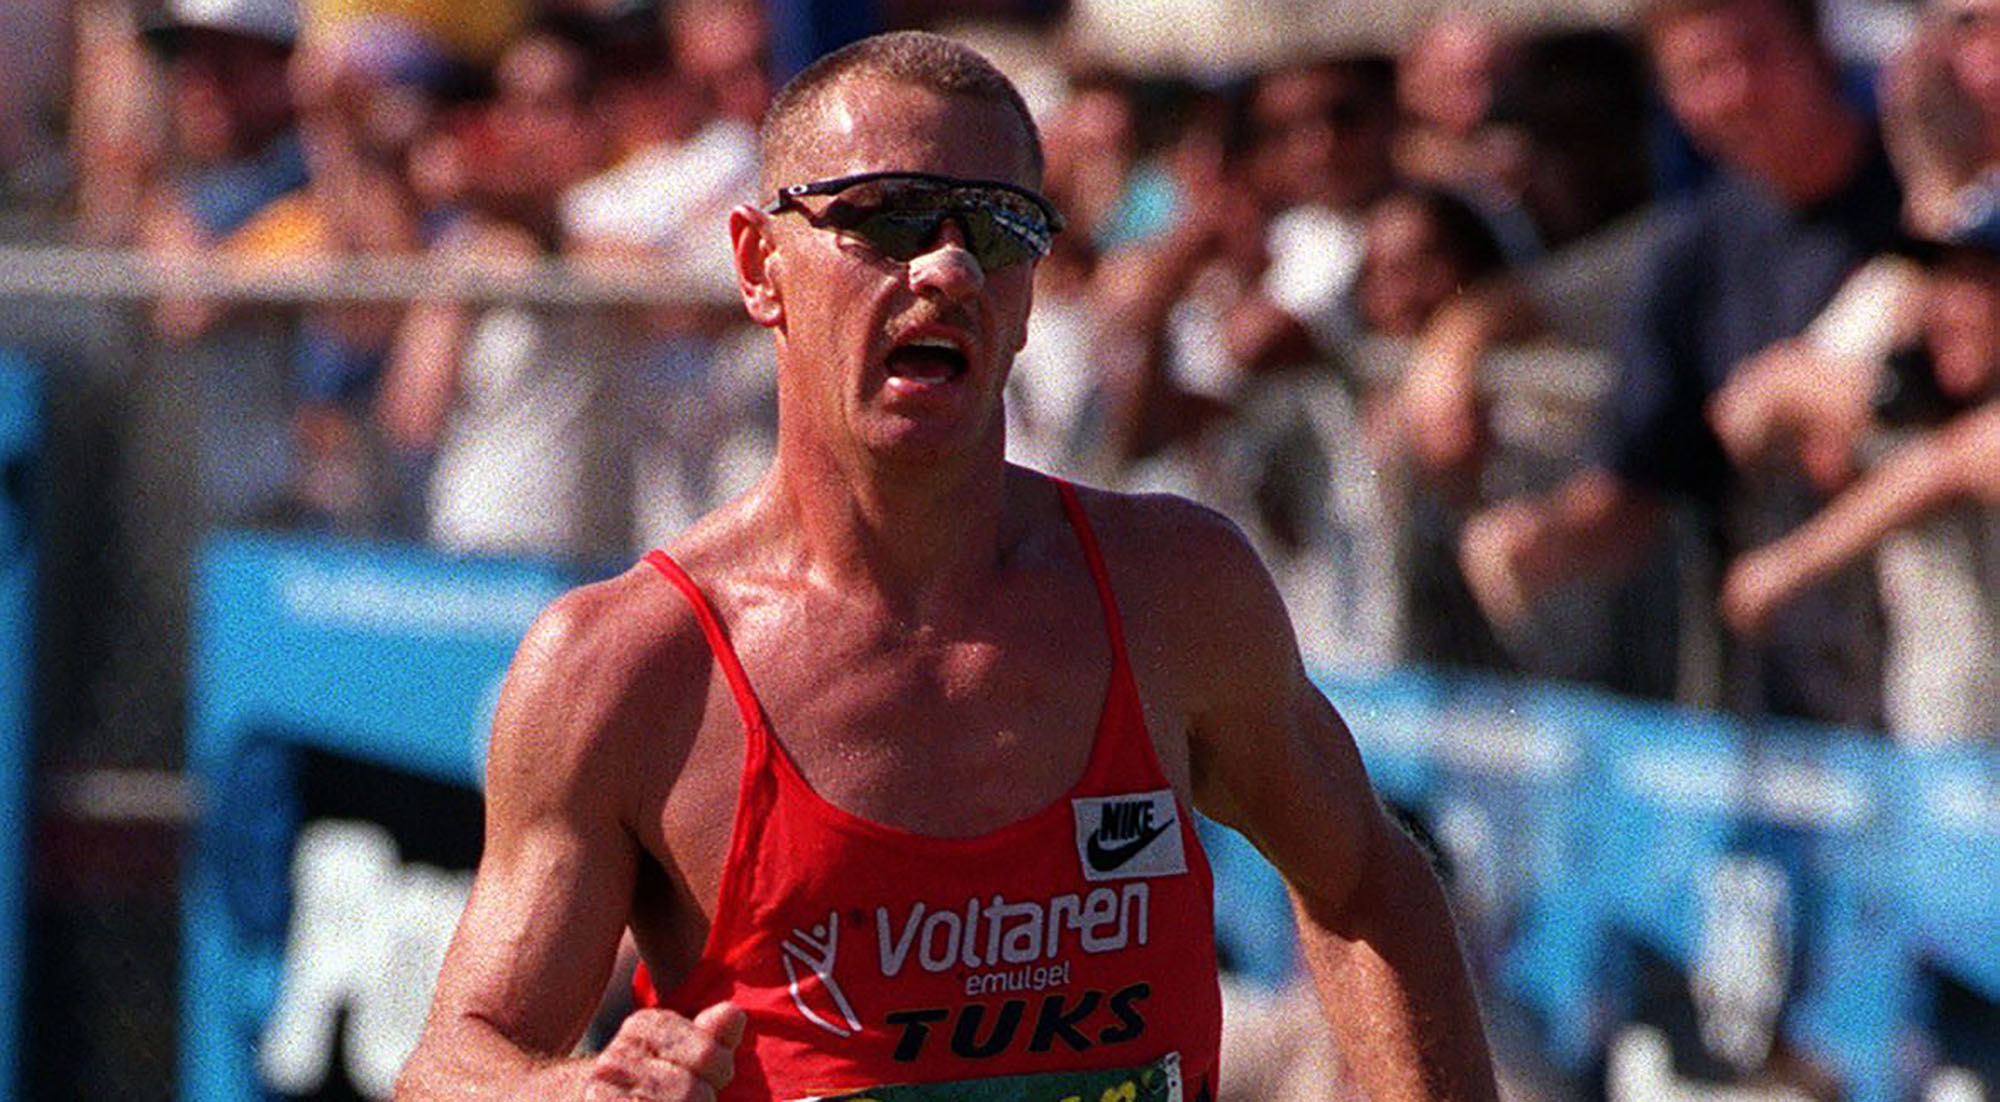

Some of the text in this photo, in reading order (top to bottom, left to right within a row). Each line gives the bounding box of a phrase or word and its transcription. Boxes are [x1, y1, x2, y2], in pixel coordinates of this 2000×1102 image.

[1099, 801, 1154, 841] NIKE
[877, 883, 1149, 977] Voltaren
[965, 960, 1071, 997] emulgel
[886, 983, 1151, 1062] TUKS
